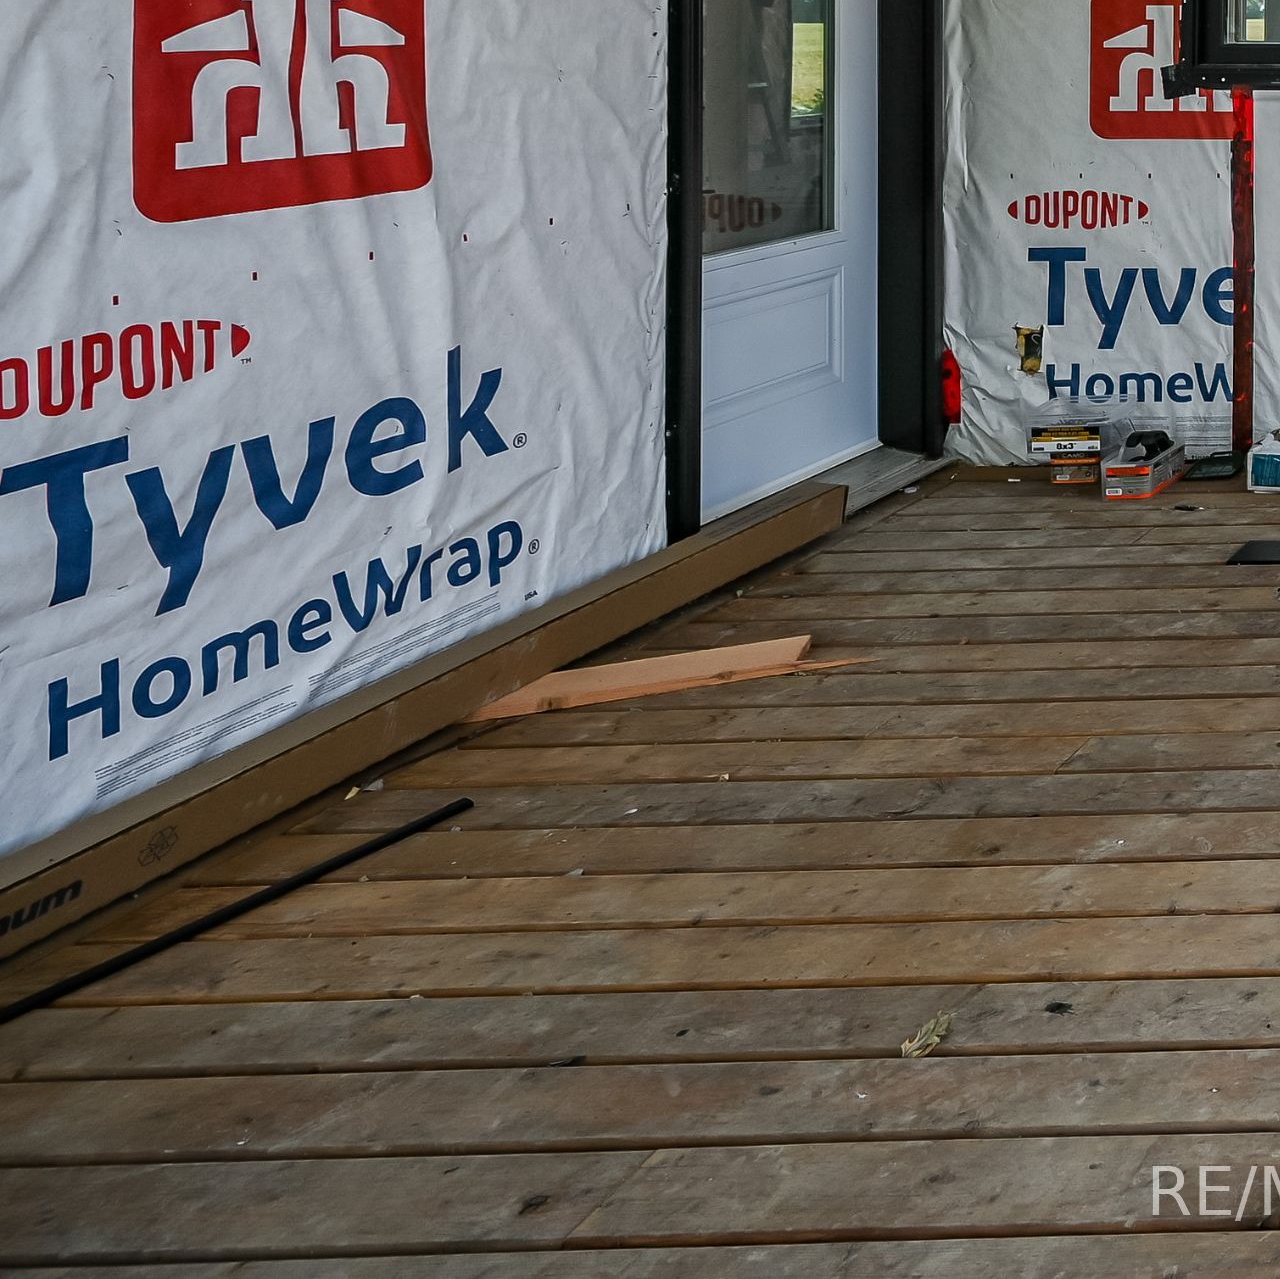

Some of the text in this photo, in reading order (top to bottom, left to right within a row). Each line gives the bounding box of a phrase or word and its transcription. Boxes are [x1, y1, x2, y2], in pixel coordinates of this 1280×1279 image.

[1024, 190, 1133, 230] DUPONT
[0, 319, 221, 422] DUPONT
[523, 589, 539, 602] USA
